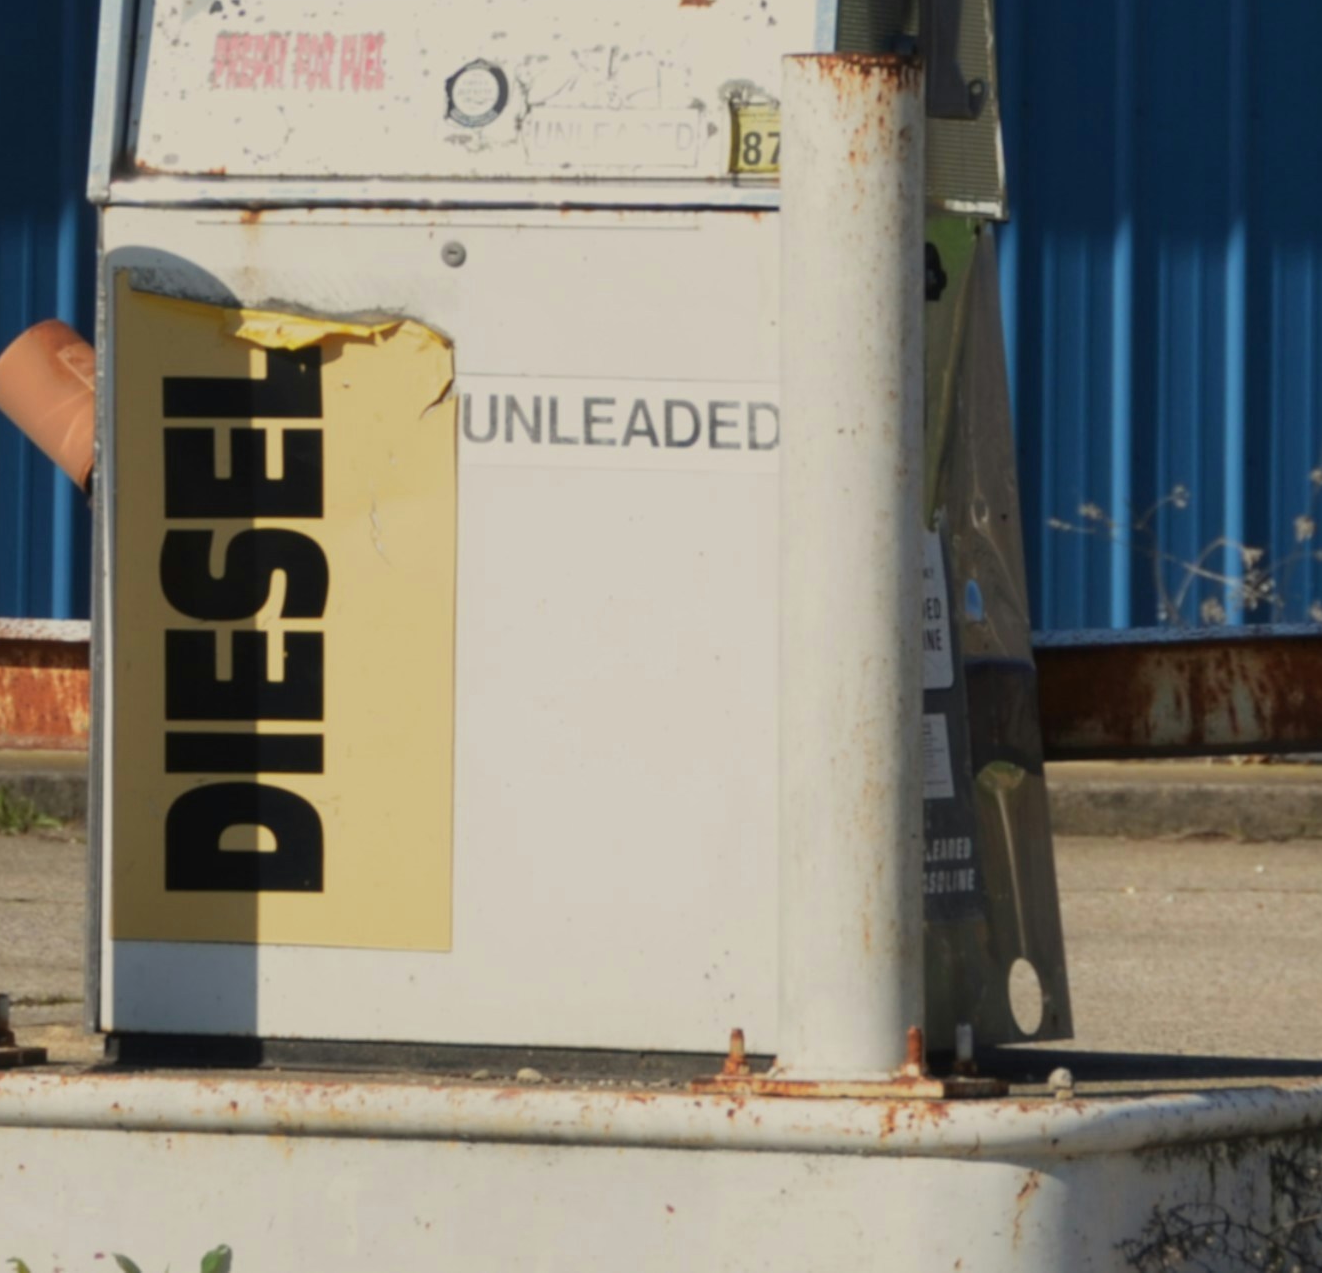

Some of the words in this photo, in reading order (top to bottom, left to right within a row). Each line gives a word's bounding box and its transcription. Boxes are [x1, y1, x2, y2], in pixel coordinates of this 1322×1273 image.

[741, 130, 781, 167] 87
[462, 392, 781, 451] UNLEADED
[158, 344, 330, 893] DIESEL
